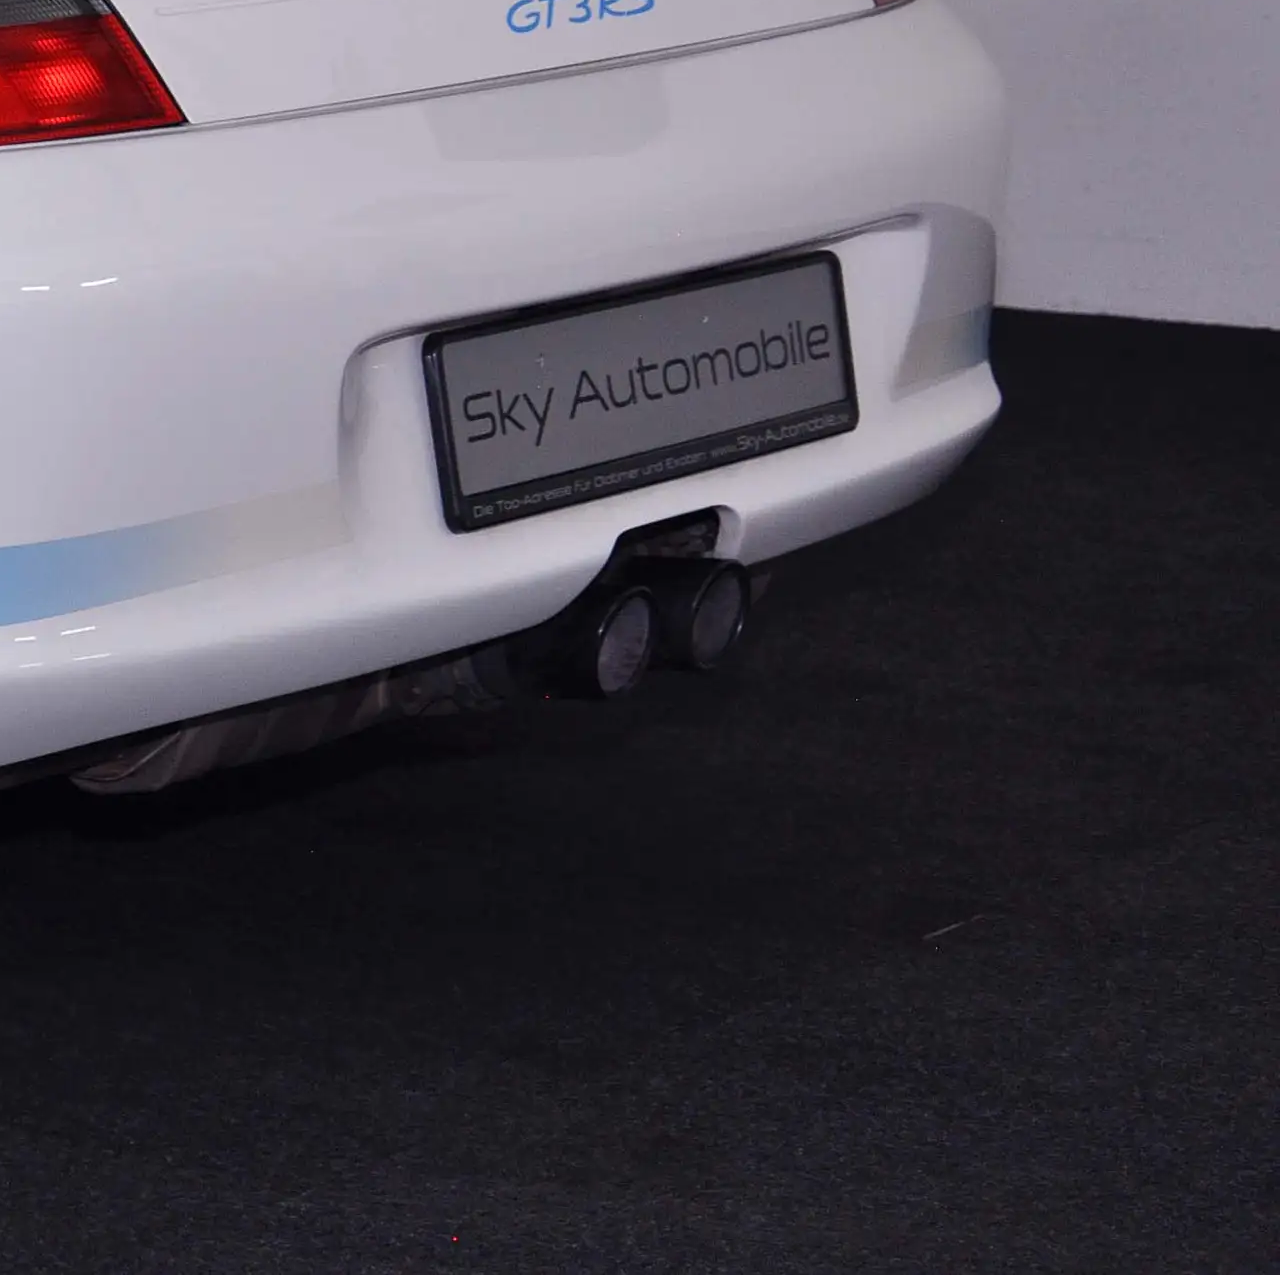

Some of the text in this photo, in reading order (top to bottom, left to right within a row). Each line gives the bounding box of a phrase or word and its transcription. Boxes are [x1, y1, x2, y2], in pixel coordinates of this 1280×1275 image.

[464, 320, 830, 446] Sky Automobile
[472, 504, 494, 519] Die
[642, 460, 664, 476] und
